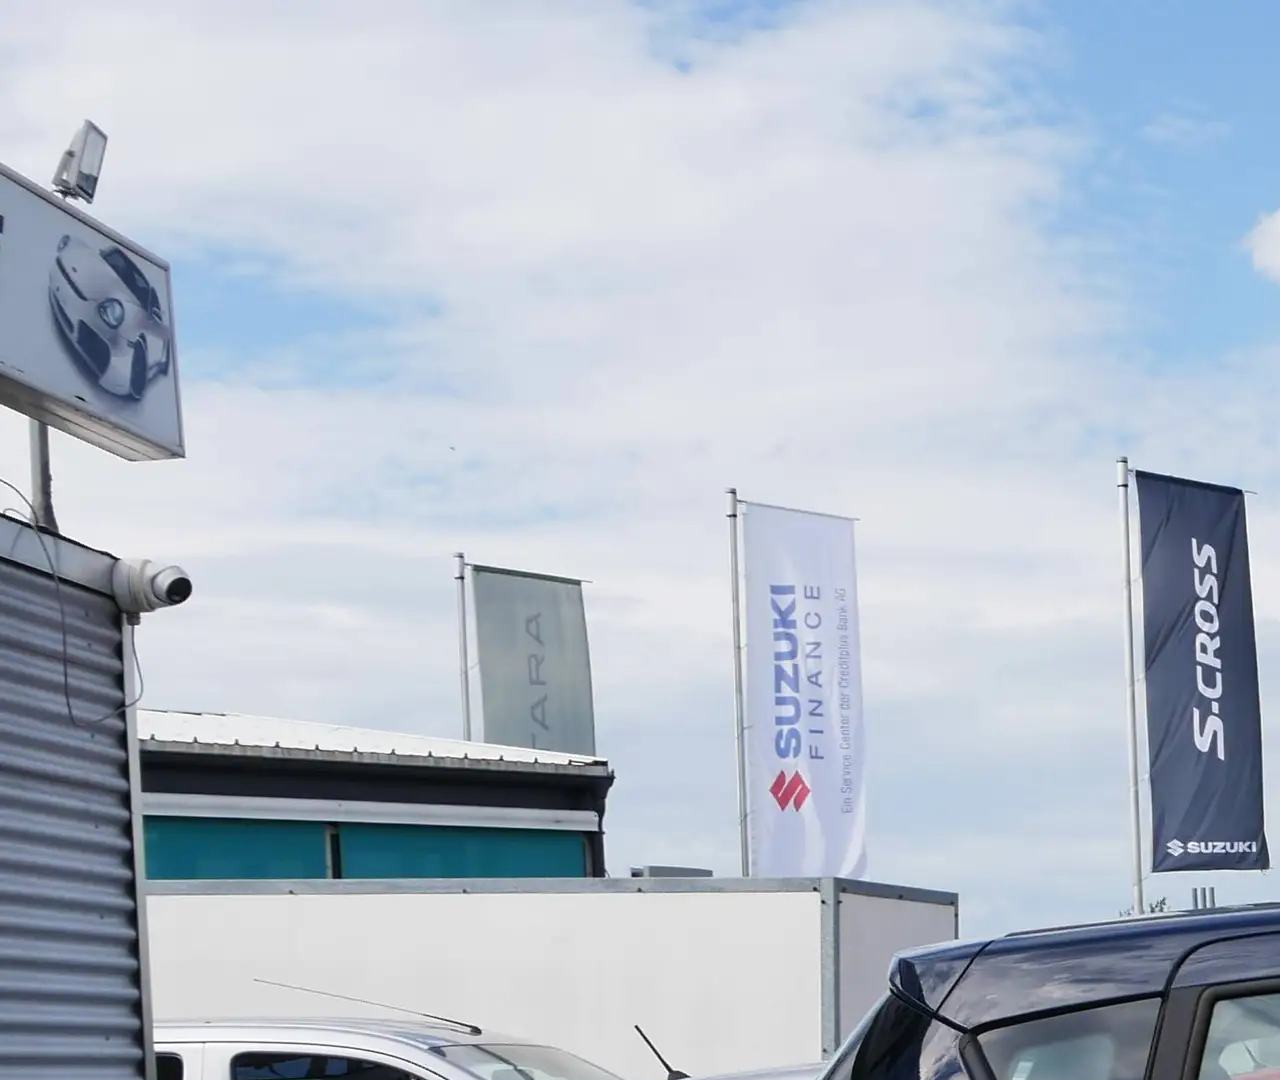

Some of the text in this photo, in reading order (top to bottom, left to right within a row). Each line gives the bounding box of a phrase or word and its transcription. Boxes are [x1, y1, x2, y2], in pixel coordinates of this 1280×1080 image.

[836, 605, 849, 631] Bank
[770, 585, 802, 759] SUZUKI
[804, 585, 824, 760] FINANCE
[840, 714, 852, 750] Center
[841, 754, 853, 794] Service
[842, 797, 854, 814] Ein
[1187, 841, 1257, 853] SUZUKI
